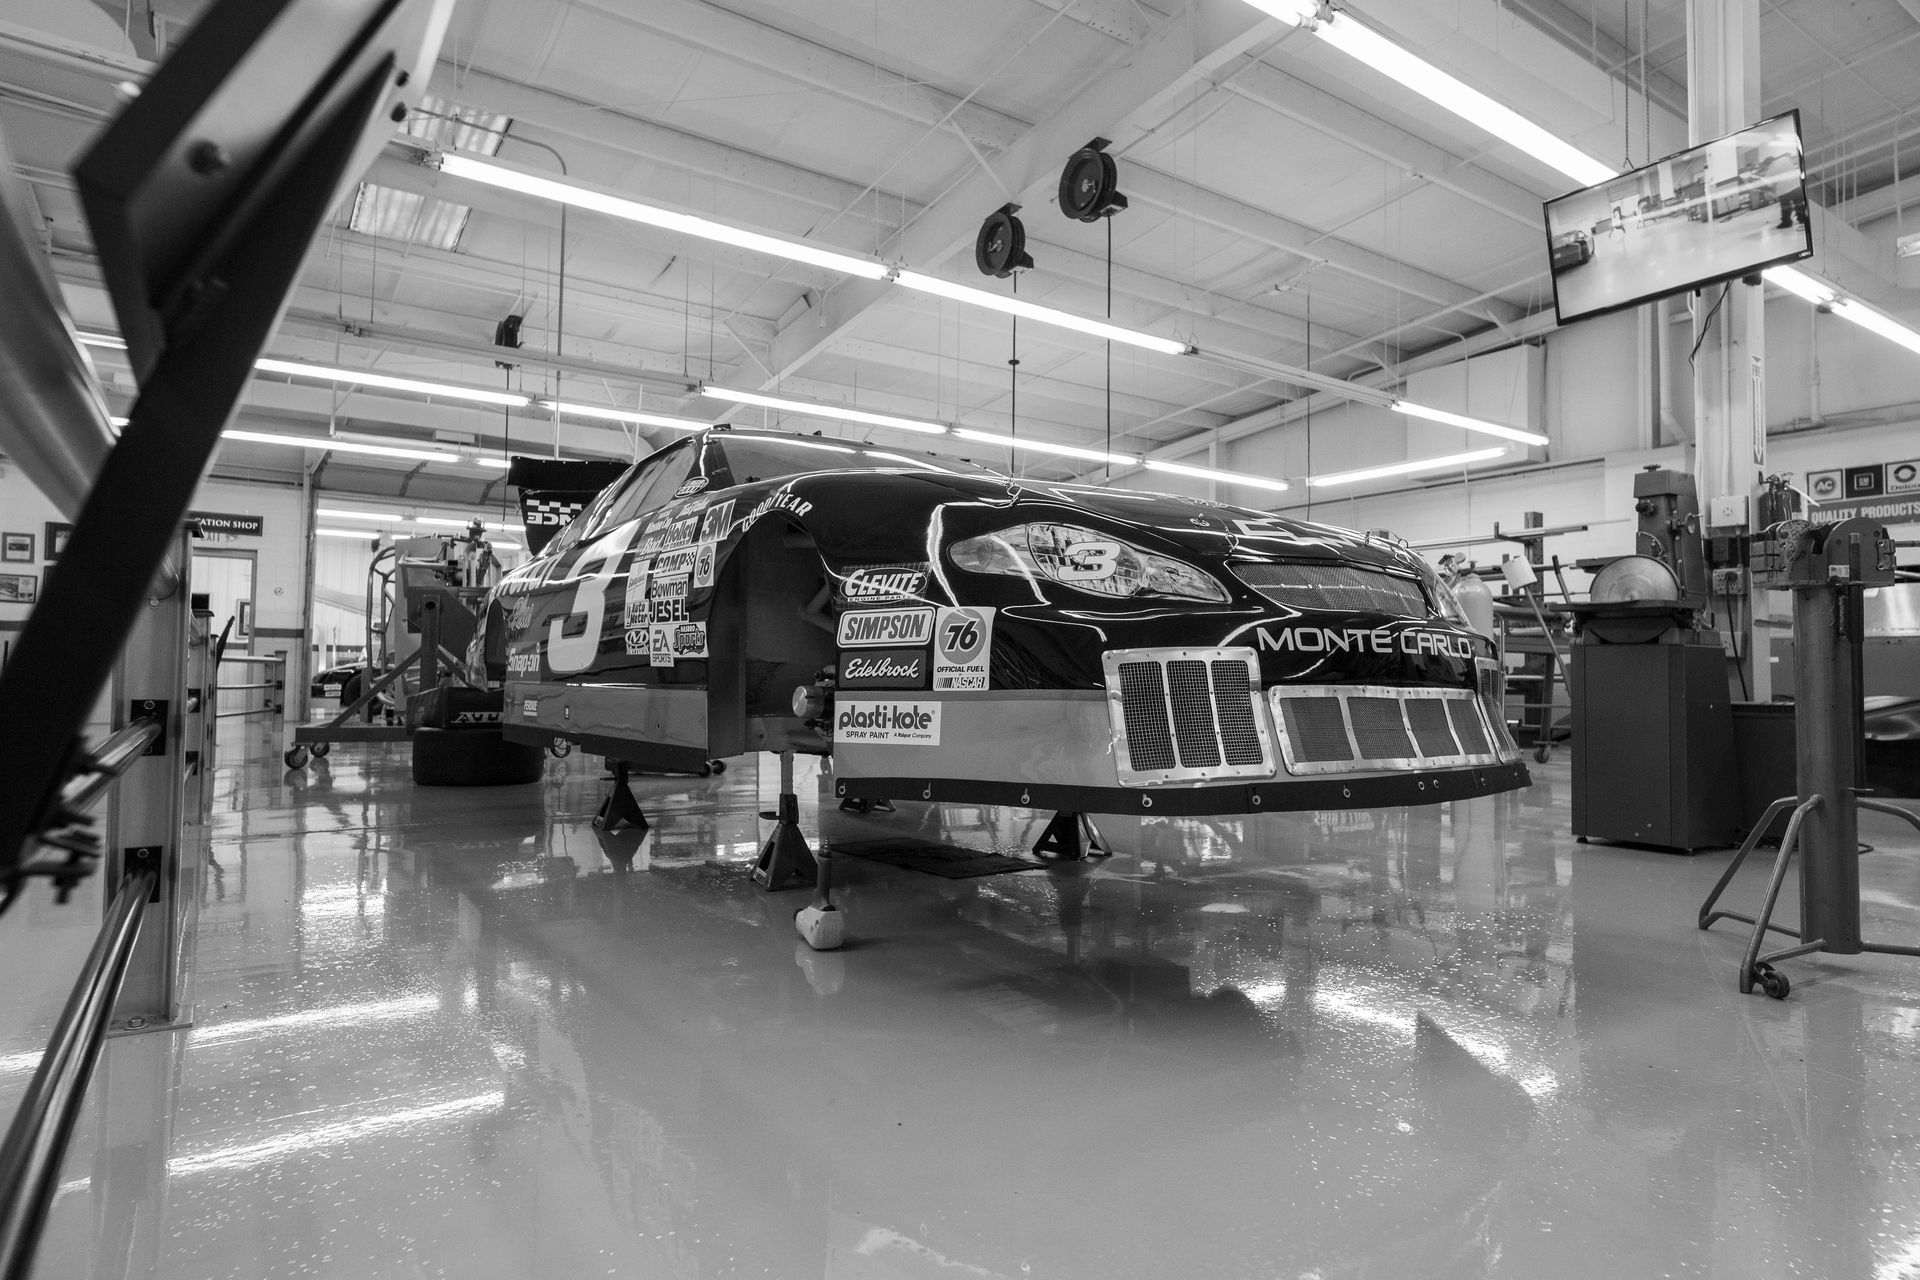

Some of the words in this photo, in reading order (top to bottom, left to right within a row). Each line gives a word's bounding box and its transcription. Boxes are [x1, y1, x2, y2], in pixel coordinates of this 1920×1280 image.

[1815, 480, 1833, 491] AC
[232, 520, 258, 530] SHOP
[701, 503, 733, 543] 3M
[1811, 507, 1857, 525] QUALITY
[1861, 501, 1920, 519] PRODUCTS
[664, 519, 696, 543] Holley
[641, 533, 665, 555] Bud
[655, 552, 687, 573] COMP
[699, 553, 711, 577] 76
[1057, 541, 1121, 581] 3
[652, 580, 687, 599] Bowman
[845, 569, 923, 596] CLEVITE
[547, 518, 642, 673] 3
[631, 613, 648, 624] Meter
[632, 602, 646, 614] Auto
[649, 597, 689, 624] JESEL
[845, 613, 926, 640] SIMPSON
[944, 619, 980, 653] 76
[653, 629, 669, 652] EA
[674, 628, 706, 654] Sports
[1256, 627, 1393, 654] MONTE
[1400, 630, 1472, 658] CARLO
[507, 648, 540, 677] Snap-on
[652, 653, 671, 663] SPORTS
[845, 657, 919, 679] Edelbrock
[950, 677, 985, 688] NASCAR
[839, 705, 932, 730] plasti-kote
